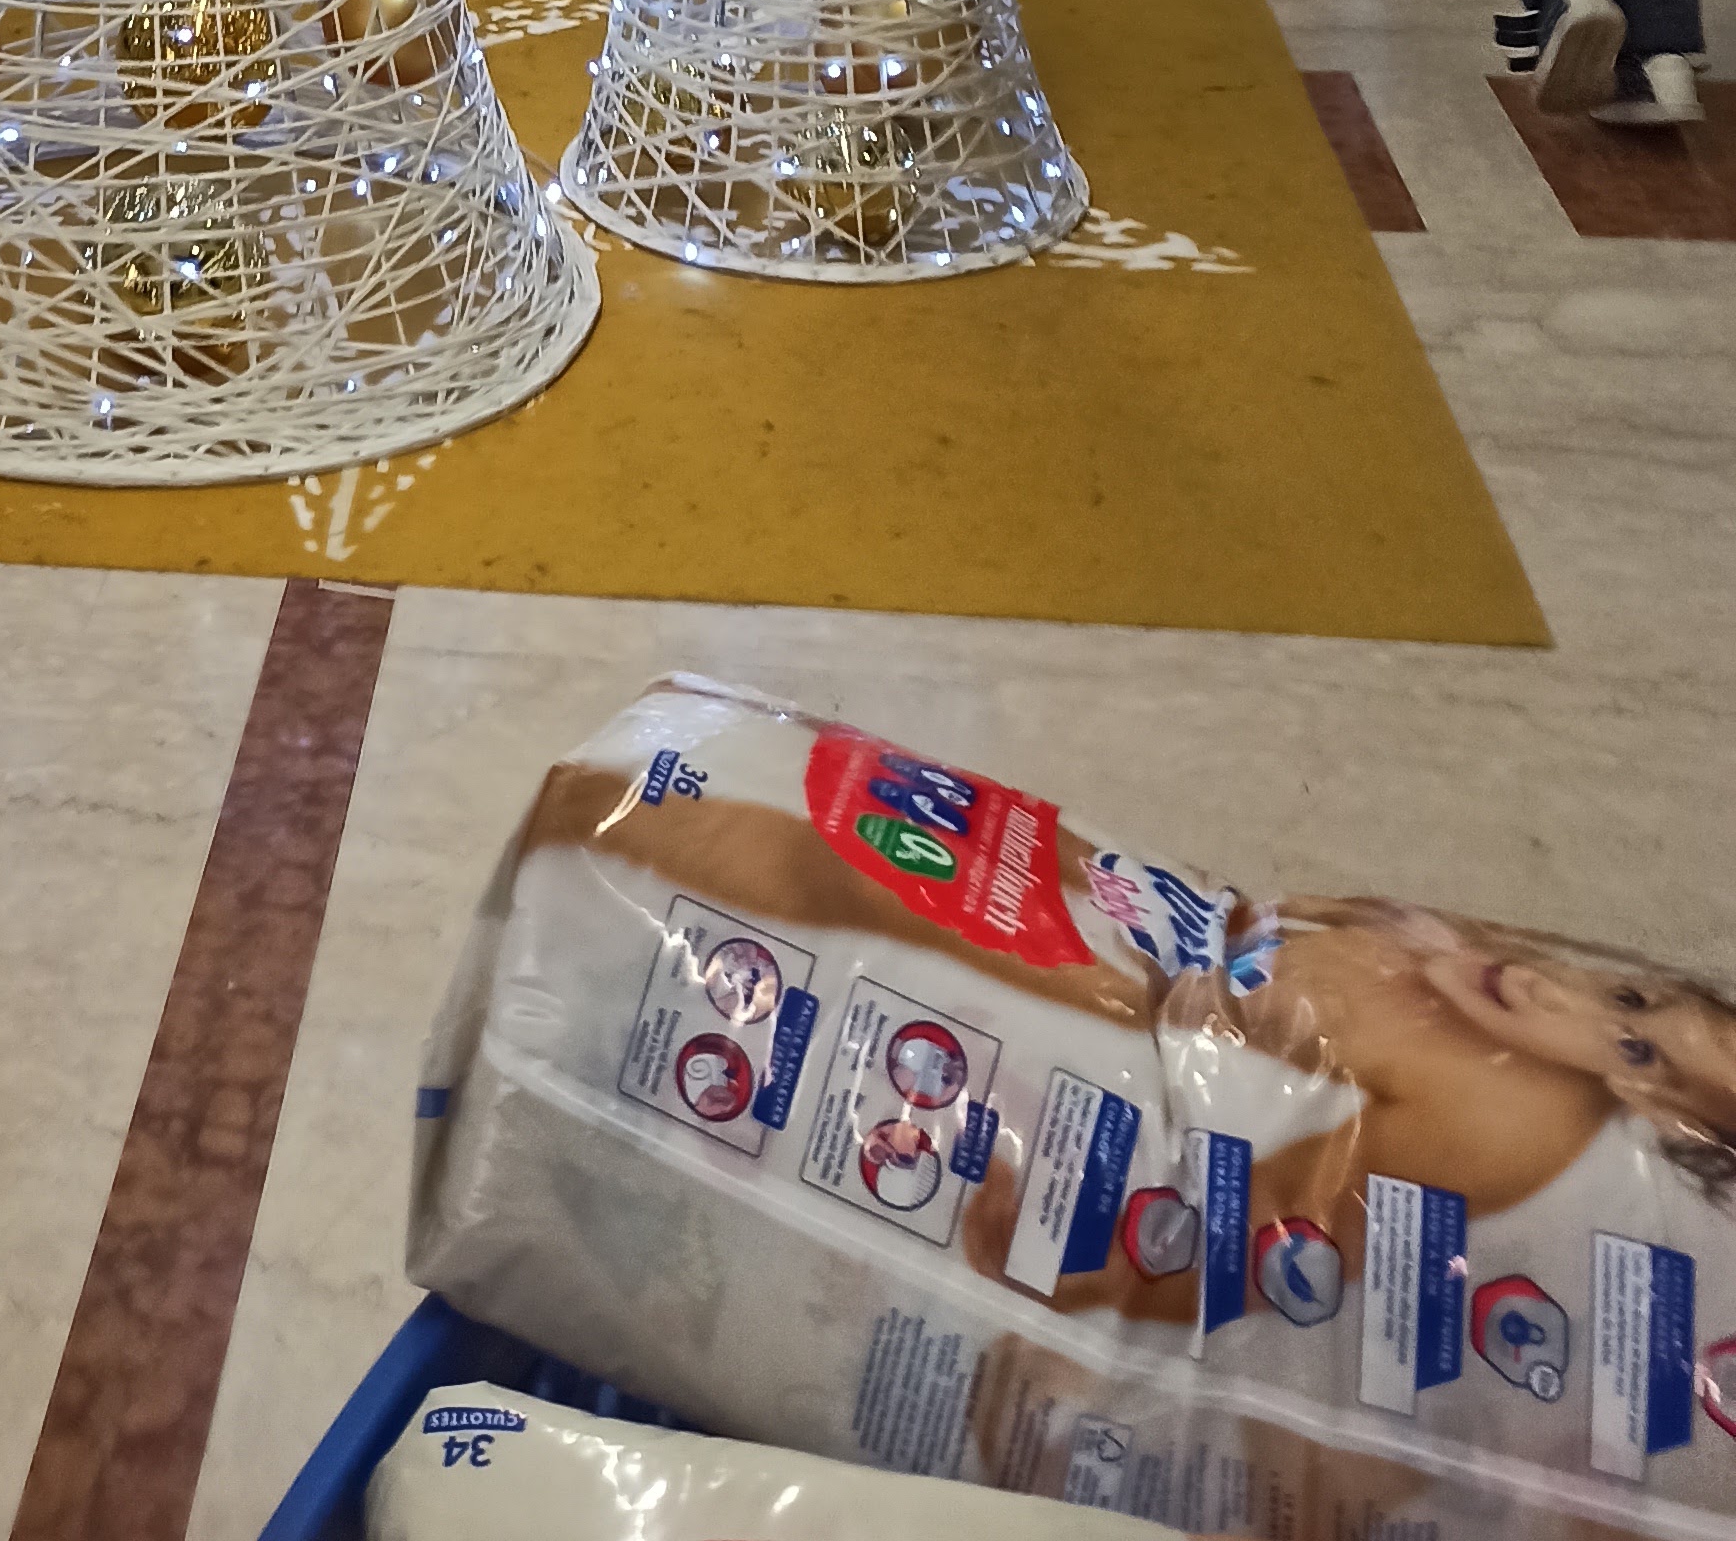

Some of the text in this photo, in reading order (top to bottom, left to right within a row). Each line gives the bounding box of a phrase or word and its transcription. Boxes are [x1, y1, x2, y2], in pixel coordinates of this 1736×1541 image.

[646, 752, 676, 797] OTTES
[677, 762, 709, 801] 36
[429, 1412, 518, 1427] CULOTTES
[441, 1432, 495, 1468] 34
